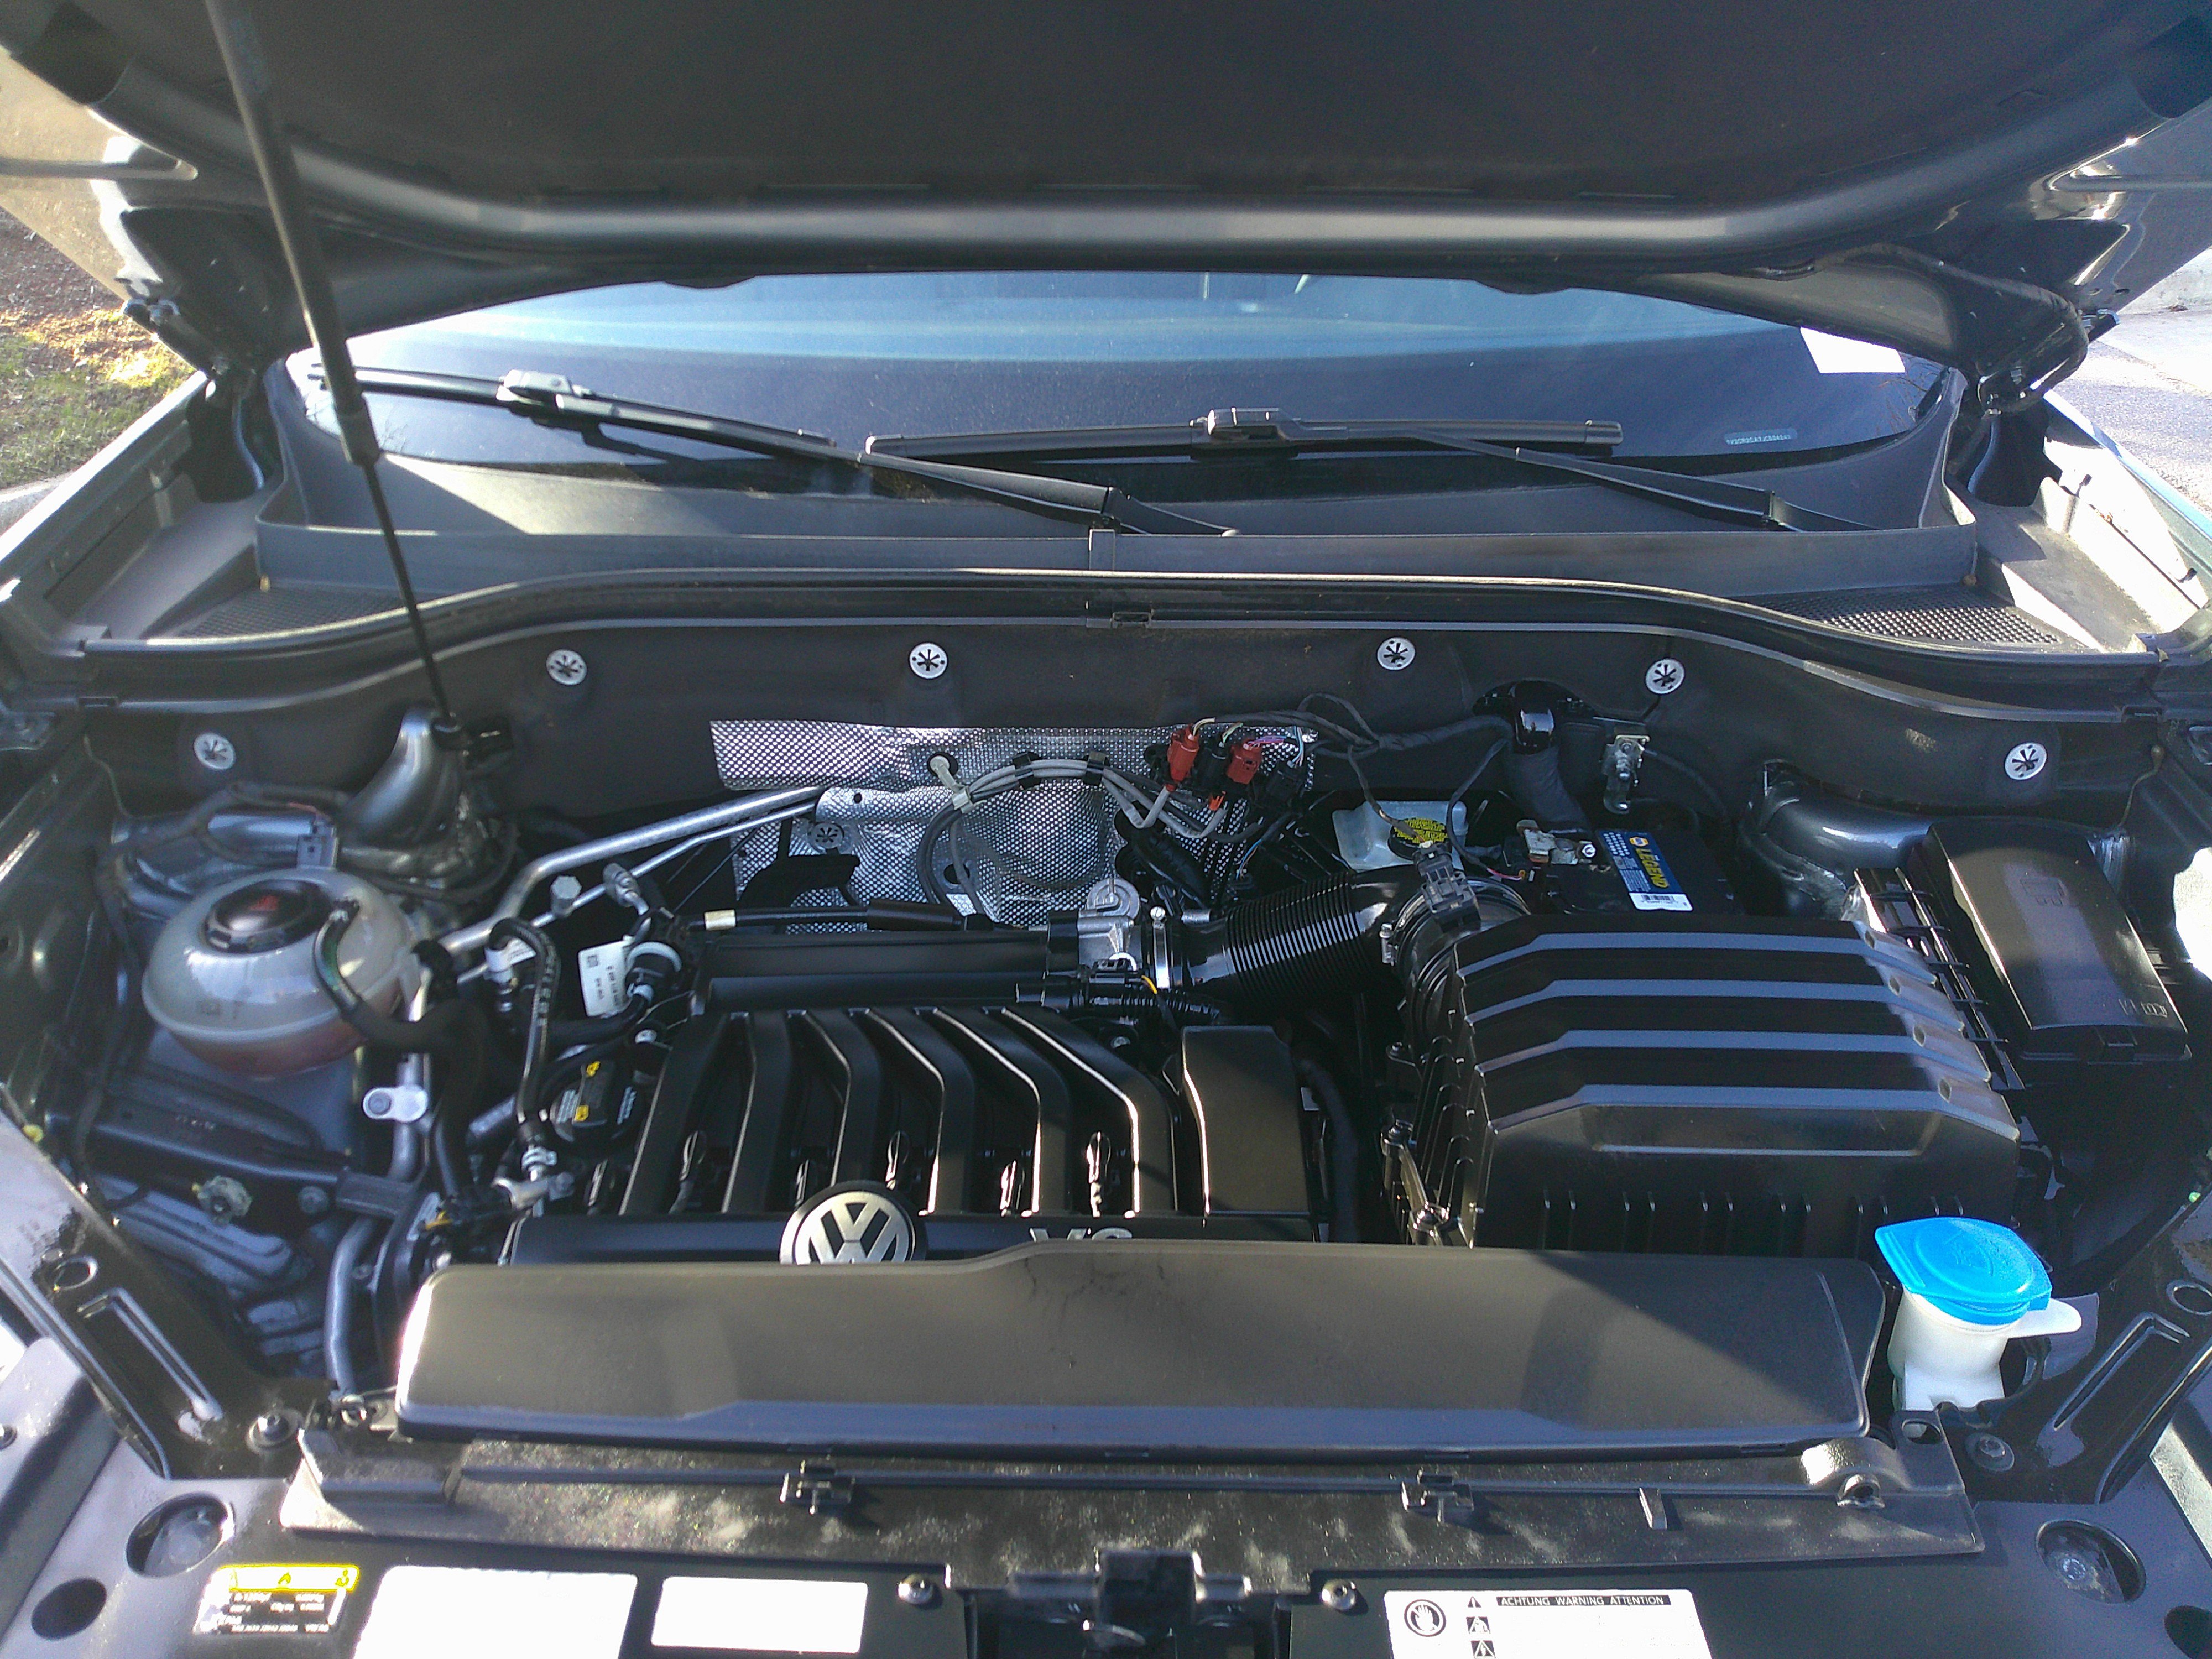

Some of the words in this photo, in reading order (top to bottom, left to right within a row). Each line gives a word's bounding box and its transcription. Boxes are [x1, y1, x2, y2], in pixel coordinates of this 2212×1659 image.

[1636, 848, 1670, 888] LEGEND
[1501, 1596, 1550, 1605] ACHTUNG
[1555, 1595, 1605, 1605] WARNING
[1610, 1595, 1664, 1605] ATTENTION
